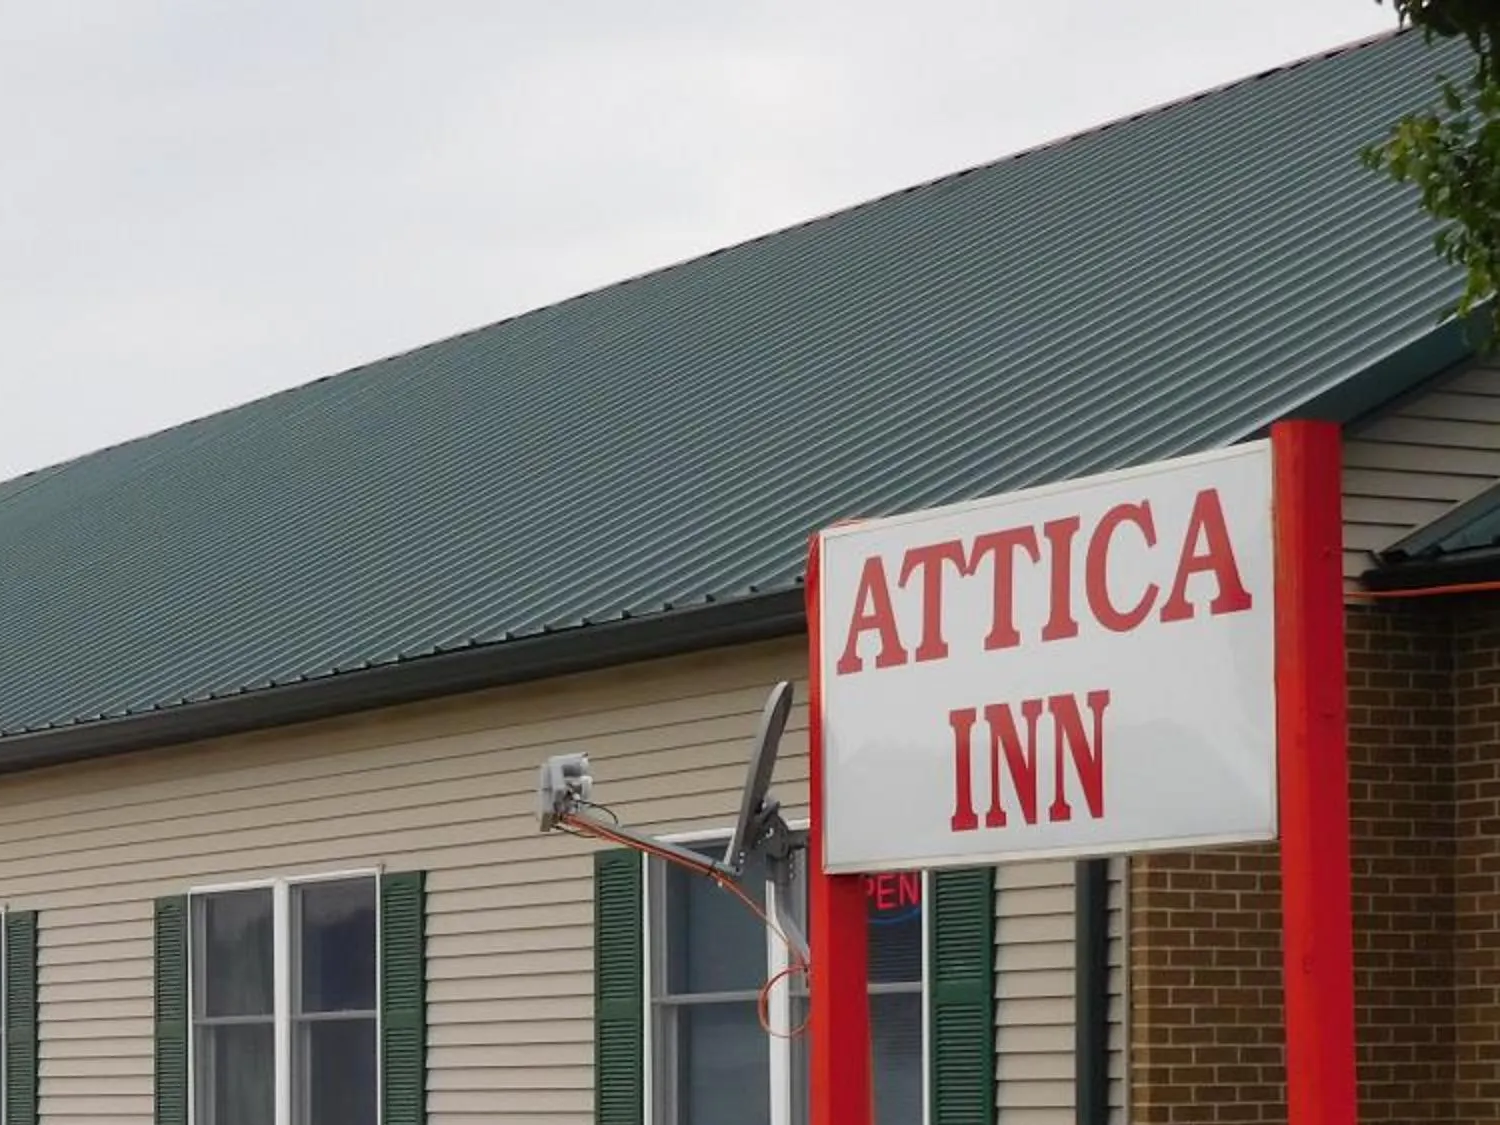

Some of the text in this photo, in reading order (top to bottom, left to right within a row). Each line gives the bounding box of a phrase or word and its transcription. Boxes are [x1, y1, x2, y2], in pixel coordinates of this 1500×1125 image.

[836, 488, 1252, 675] ATTICA
[949, 689, 1110, 832] INN
[864, 869, 919, 910] EN
